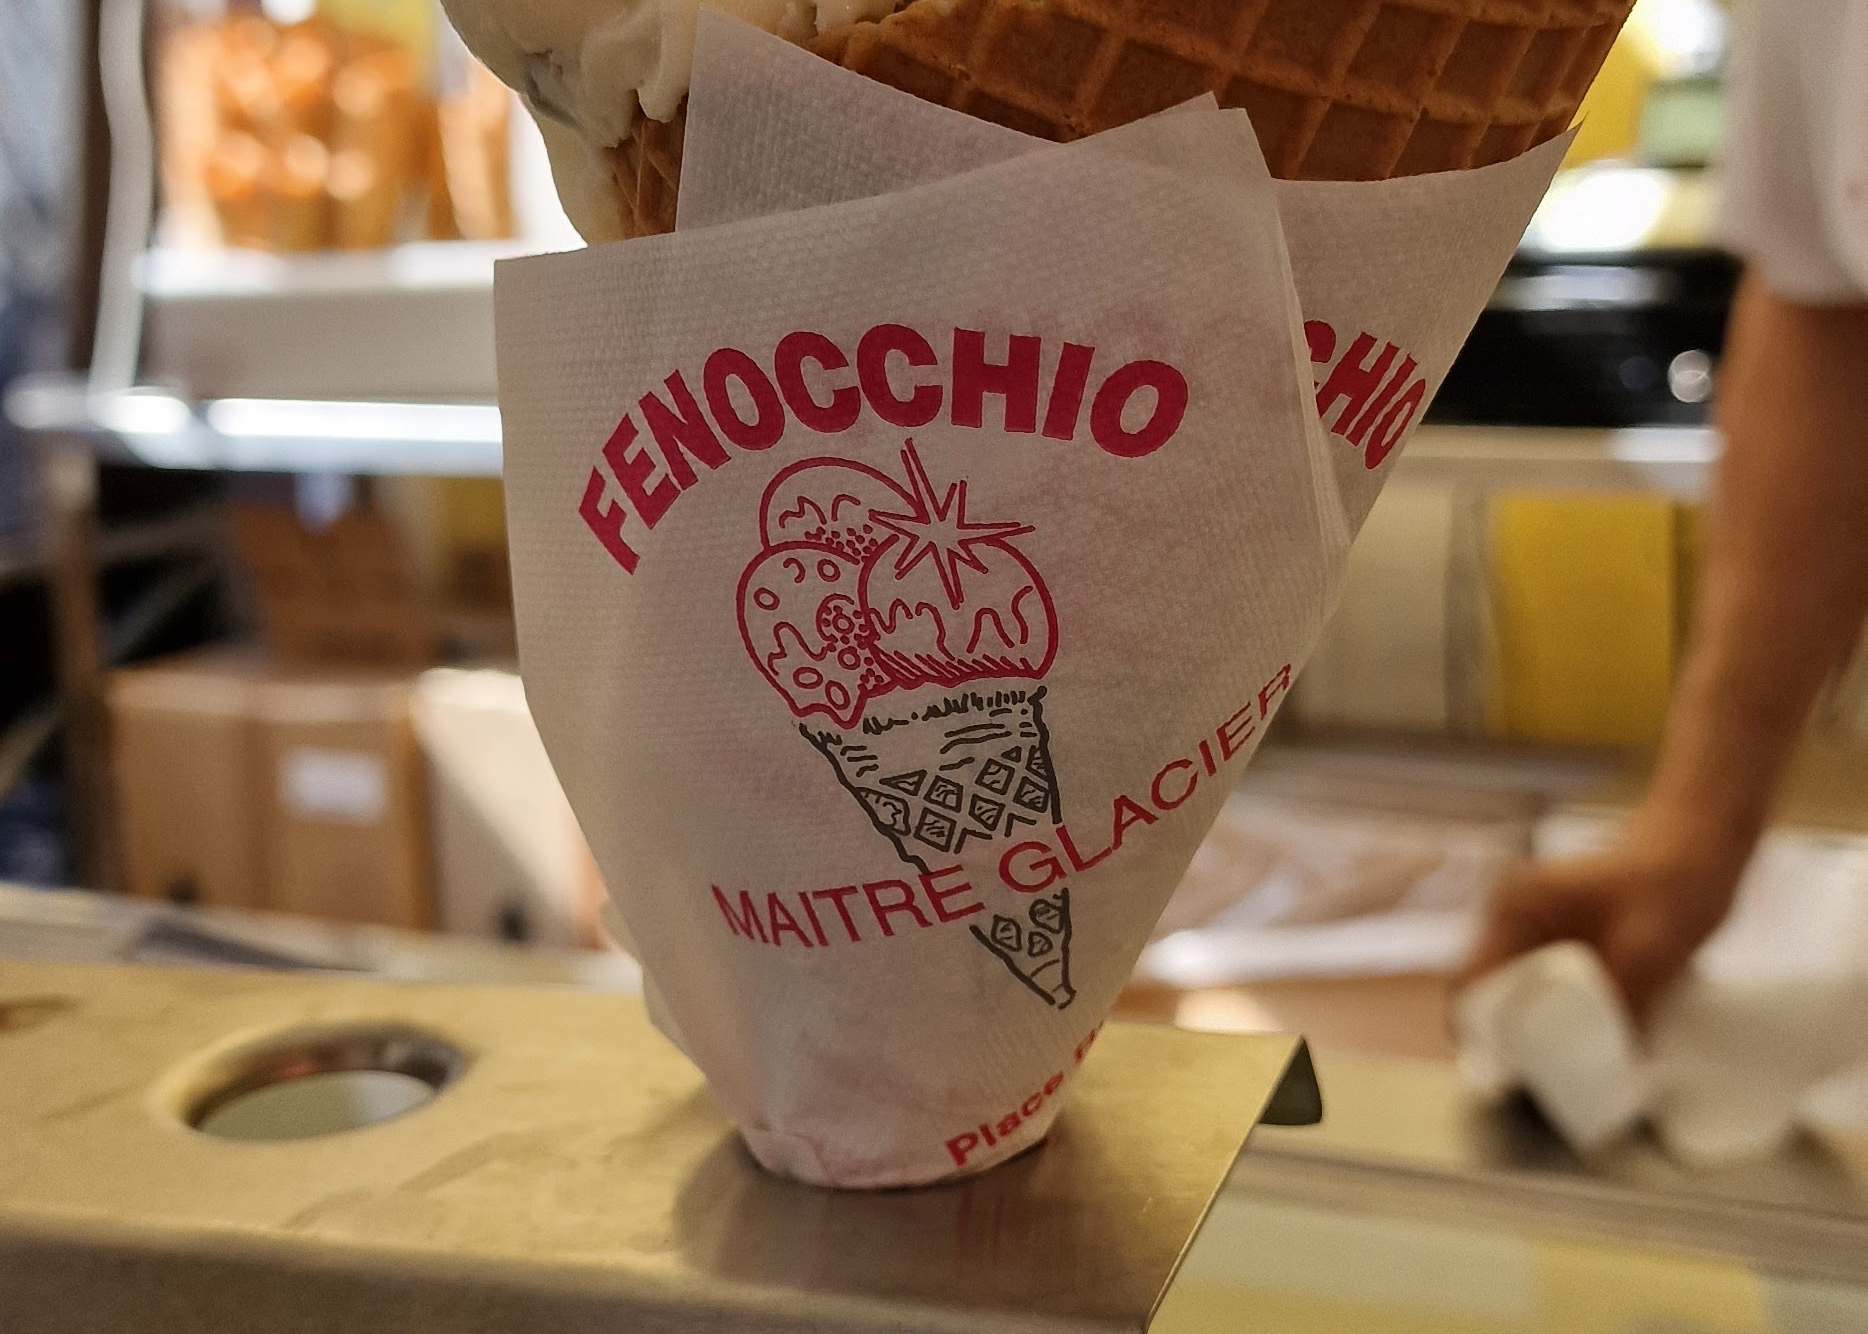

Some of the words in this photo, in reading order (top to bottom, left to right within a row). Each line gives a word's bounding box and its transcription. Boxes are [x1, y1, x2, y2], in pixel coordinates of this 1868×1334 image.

[578, 323, 1190, 576] FENOCCHIO
[711, 864, 985, 948] MAITRE
[998, 663, 1292, 894] GLACIER
[945, 1070, 1065, 1166] Place
